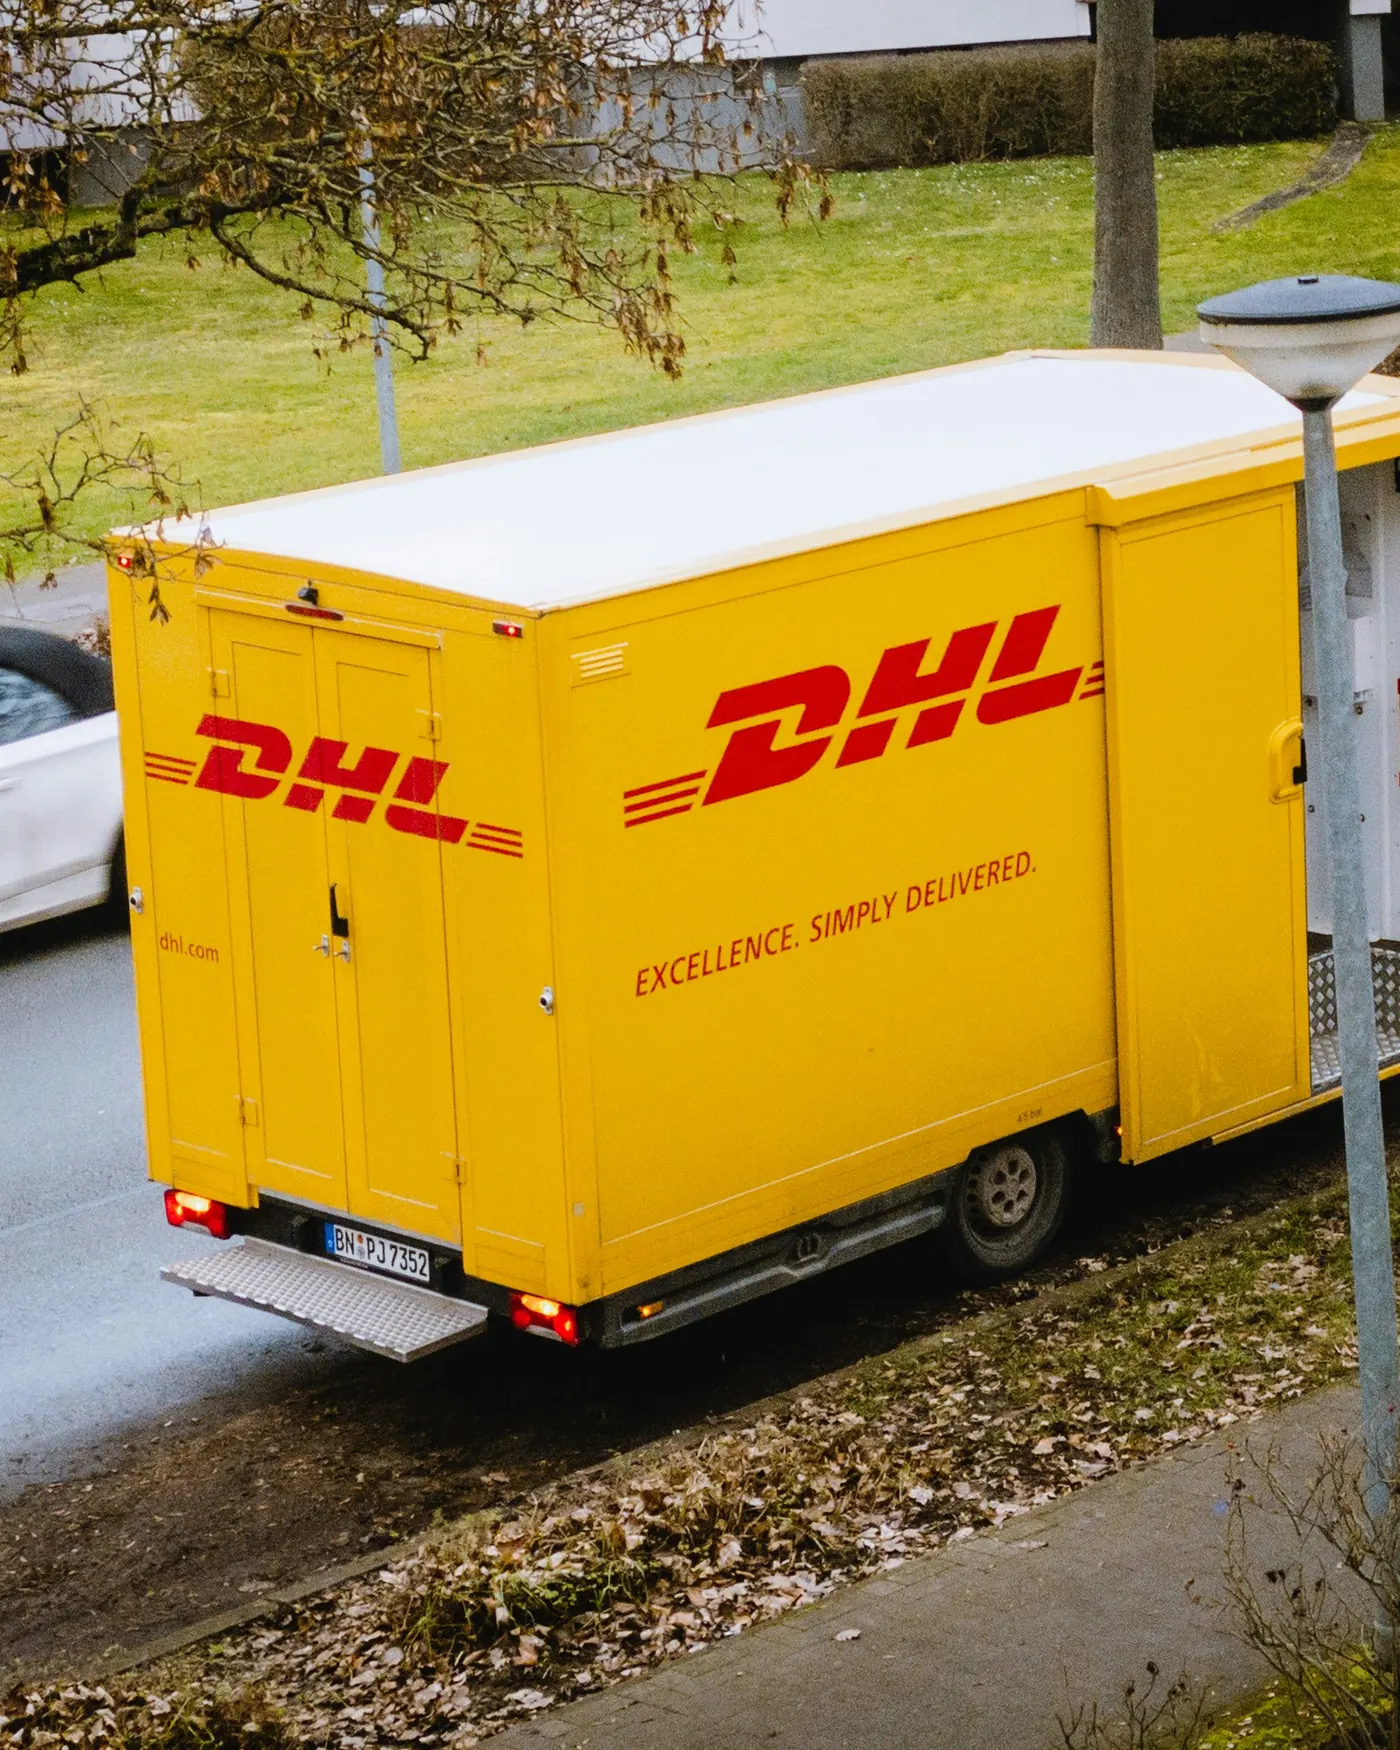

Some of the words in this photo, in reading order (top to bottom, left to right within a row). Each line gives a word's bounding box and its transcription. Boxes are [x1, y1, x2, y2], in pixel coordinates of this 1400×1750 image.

[702, 605, 1083, 807] DHL
[194, 714, 469, 844] DHL
[160, 932, 219, 963] dhl.com
[635, 923, 799, 997] EXCELLENCE.
[810, 892, 898, 943] SIMPLY
[905, 851, 1037, 913] DELIVERED.
[335, 1228, 355, 1255] BN
[366, 1237, 386, 1264] PJ
[389, 1244, 428, 1277] 7352
